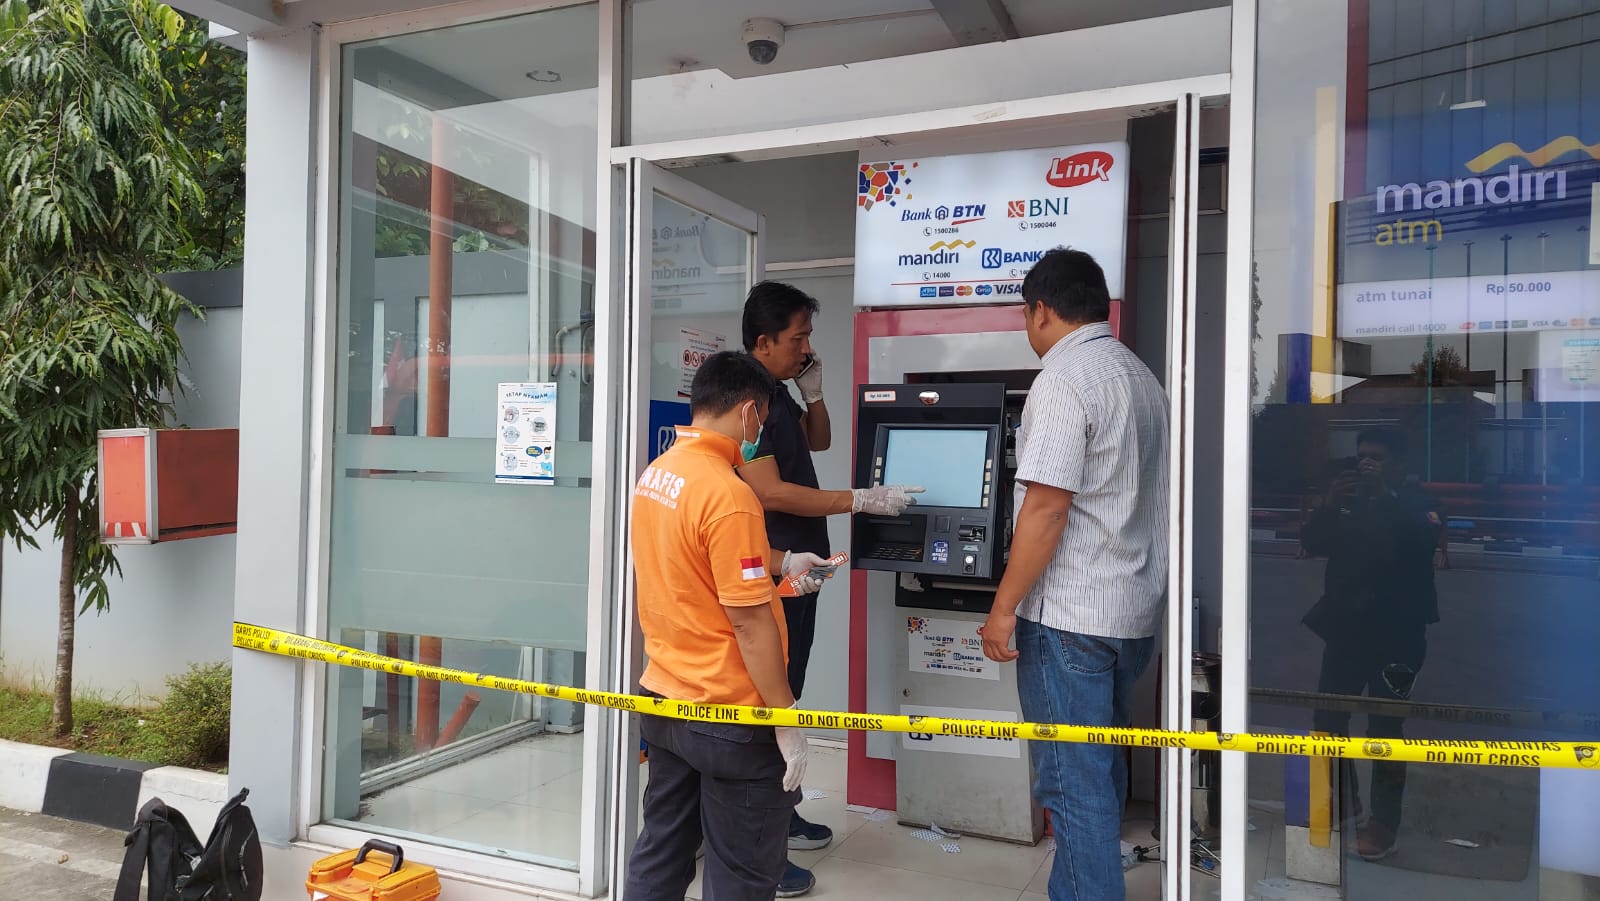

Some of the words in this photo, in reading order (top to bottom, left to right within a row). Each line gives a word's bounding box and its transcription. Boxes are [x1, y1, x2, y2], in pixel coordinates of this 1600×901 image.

[1050, 157, 1109, 182] Link
[1376, 165, 1567, 212] mandiri
[901, 207, 932, 222] Bank
[953, 204, 986, 218] BTN
[1029, 197, 1069, 217] BNI
[1375, 219, 1443, 246] atm
[898, 250, 959, 266] mandiri
[1004, 251, 1042, 263] BANK
[993, 284, 1022, 295] VISA
[1356, 290, 1386, 303] atm
[1391, 287, 1432, 302] tunai
[1486, 283, 1505, 296] Rp
[1509, 281, 1551, 293] 50.000
[1355, 325, 1395, 334] mandiri
[1399, 323, 1414, 333] call
[1418, 323, 1446, 332] 14000
[236, 625, 251, 637] GARIS
[252, 628, 270, 640] POLISI
[237, 637, 253, 648] POLICE
[254, 640, 264, 650] LINE
[308, 651, 326, 661] CROSS
[351, 658, 370, 669] POLICE
[372, 662, 385, 671] LINE
[416, 669, 425, 678] DO
[427, 671, 438, 681] NOT
[440, 673, 463, 684] CROSS
[494, 681, 518, 691] POLICE
[521, 684, 537, 694] LINE
[576, 692, 587, 703] DO
[590, 693, 607, 706] NOT
[608, 696, 636, 710] CROSS
[677, 704, 712, 719] POLICE
[715, 707, 740, 721] LINE
[798, 713, 813, 726] DO
[818, 715, 840, 728] NOT
[843, 717, 883, 730] CROSS
[942, 722, 985, 736] POLICE
[991, 725, 1019, 738] LINE
[1087, 732, 1104, 744] DO
[1111, 734, 1136, 746] NOT
[1141, 735, 1186, 748] CROSS
[1403, 739, 1479, 749] DILARANG
[1485, 741, 1561, 752] MELINTAS
[1256, 742, 1306, 755] POLICE
[1313, 744, 1346, 757] LINE
[1427, 751, 1446, 763] DO
[1453, 752, 1483, 765] NOT
[1489, 753, 1540, 767] CROSS
